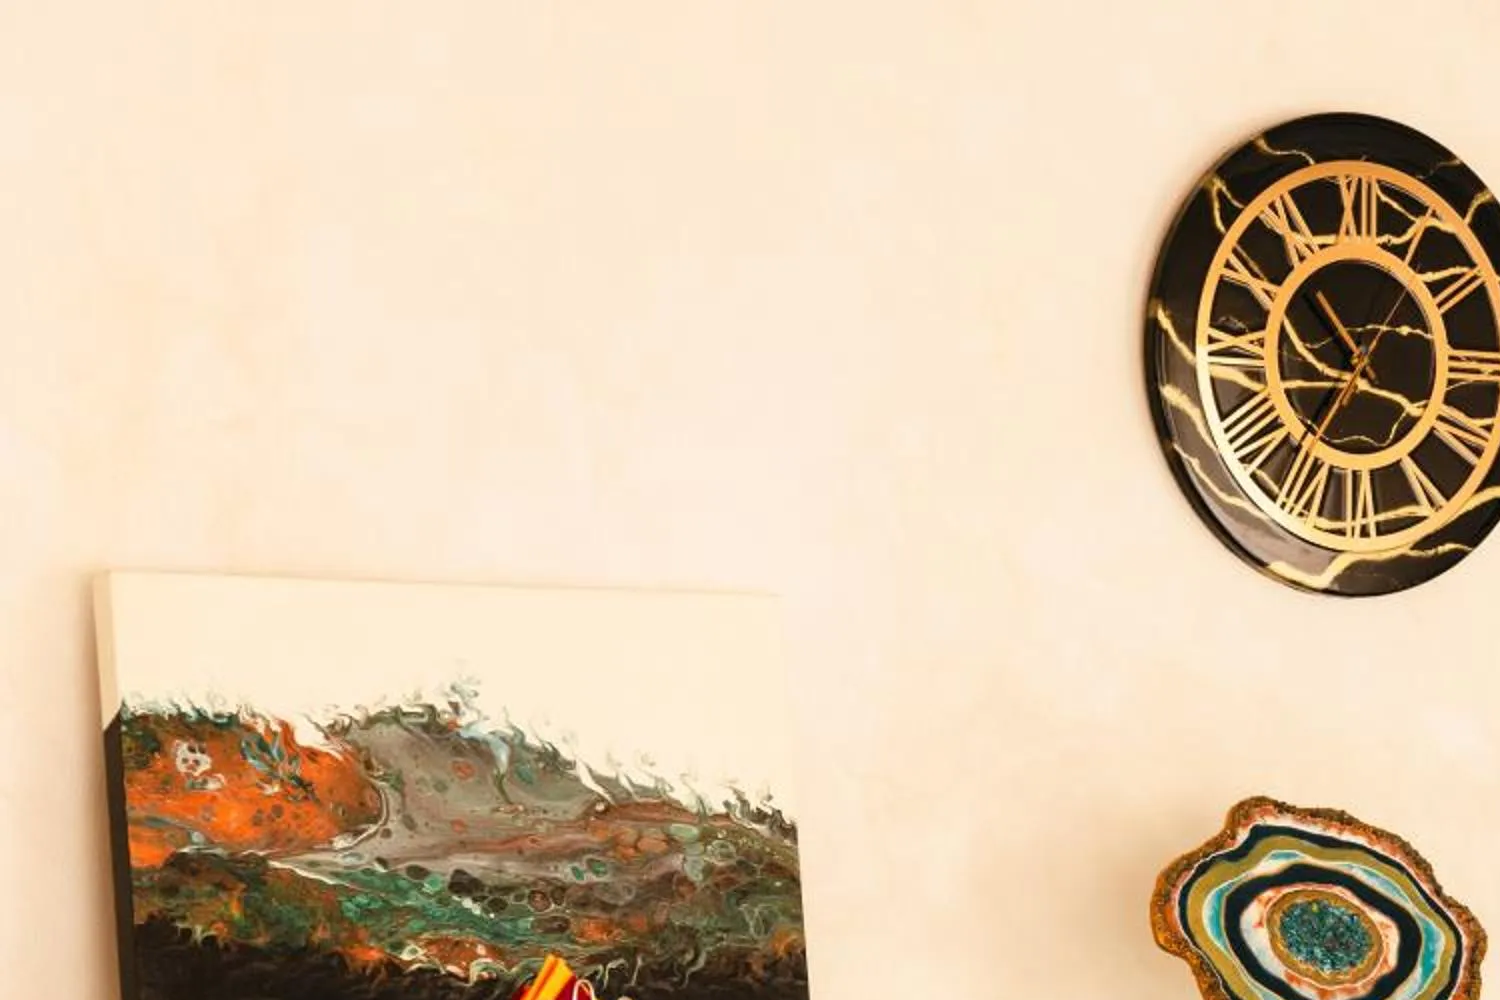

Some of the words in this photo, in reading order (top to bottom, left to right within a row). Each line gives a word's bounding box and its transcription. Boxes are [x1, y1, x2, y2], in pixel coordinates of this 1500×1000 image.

[1260, 192, 1319, 268] XI
[1338, 175, 1377, 243] XII
[1219, 249, 1282, 310] X
[1433, 265, 1487, 315] II
[1207, 329, 1265, 366] IX
[1219, 386, 1291, 476] VIII
[1431, 404, 1493, 466] IV
[1345, 466, 1377, 540] VI
[1400, 455, 1450, 513] V
